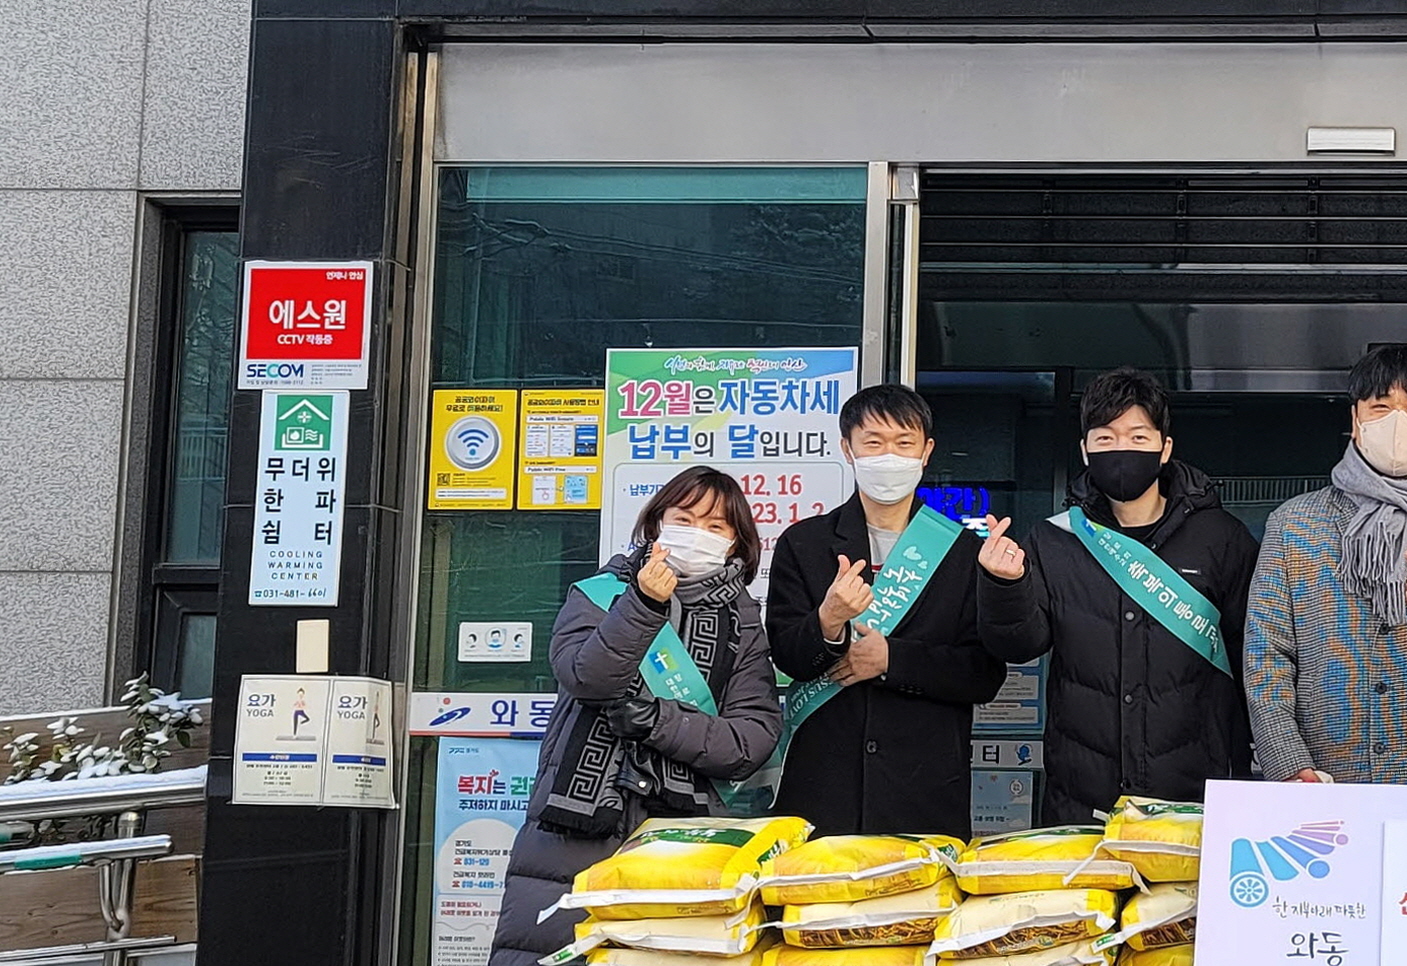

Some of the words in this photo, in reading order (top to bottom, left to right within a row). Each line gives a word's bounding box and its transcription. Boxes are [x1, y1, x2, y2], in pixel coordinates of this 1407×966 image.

[269, 300, 347, 330] 에스원
[277, 334, 305, 344] CCTV
[246, 364, 304, 378] SECOM
[618, 380, 716, 418] 12월은
[718, 379, 840, 415] 자동차세
[628, 425, 715, 460] 납부의
[728, 424, 831, 459] 달입니다.
[265, 457, 336, 482] 무더위
[777, 474, 802, 496] 16
[269, 550, 323, 559] COOLING
[268, 562, 323, 570] WARMING
[271, 572, 318, 580] CENTER
[247, 693, 276, 707] 요가
[337, 695, 368, 710] 요가
[246, 709, 274, 718] YOGA
[337, 710, 366, 720] YOGA
[458, 775, 506, 795] 복지는
[459, 799, 498, 811] 주저하지
[1272, 895, 1288, 919] 한
[1333, 902, 1366, 919] 따뜻한
